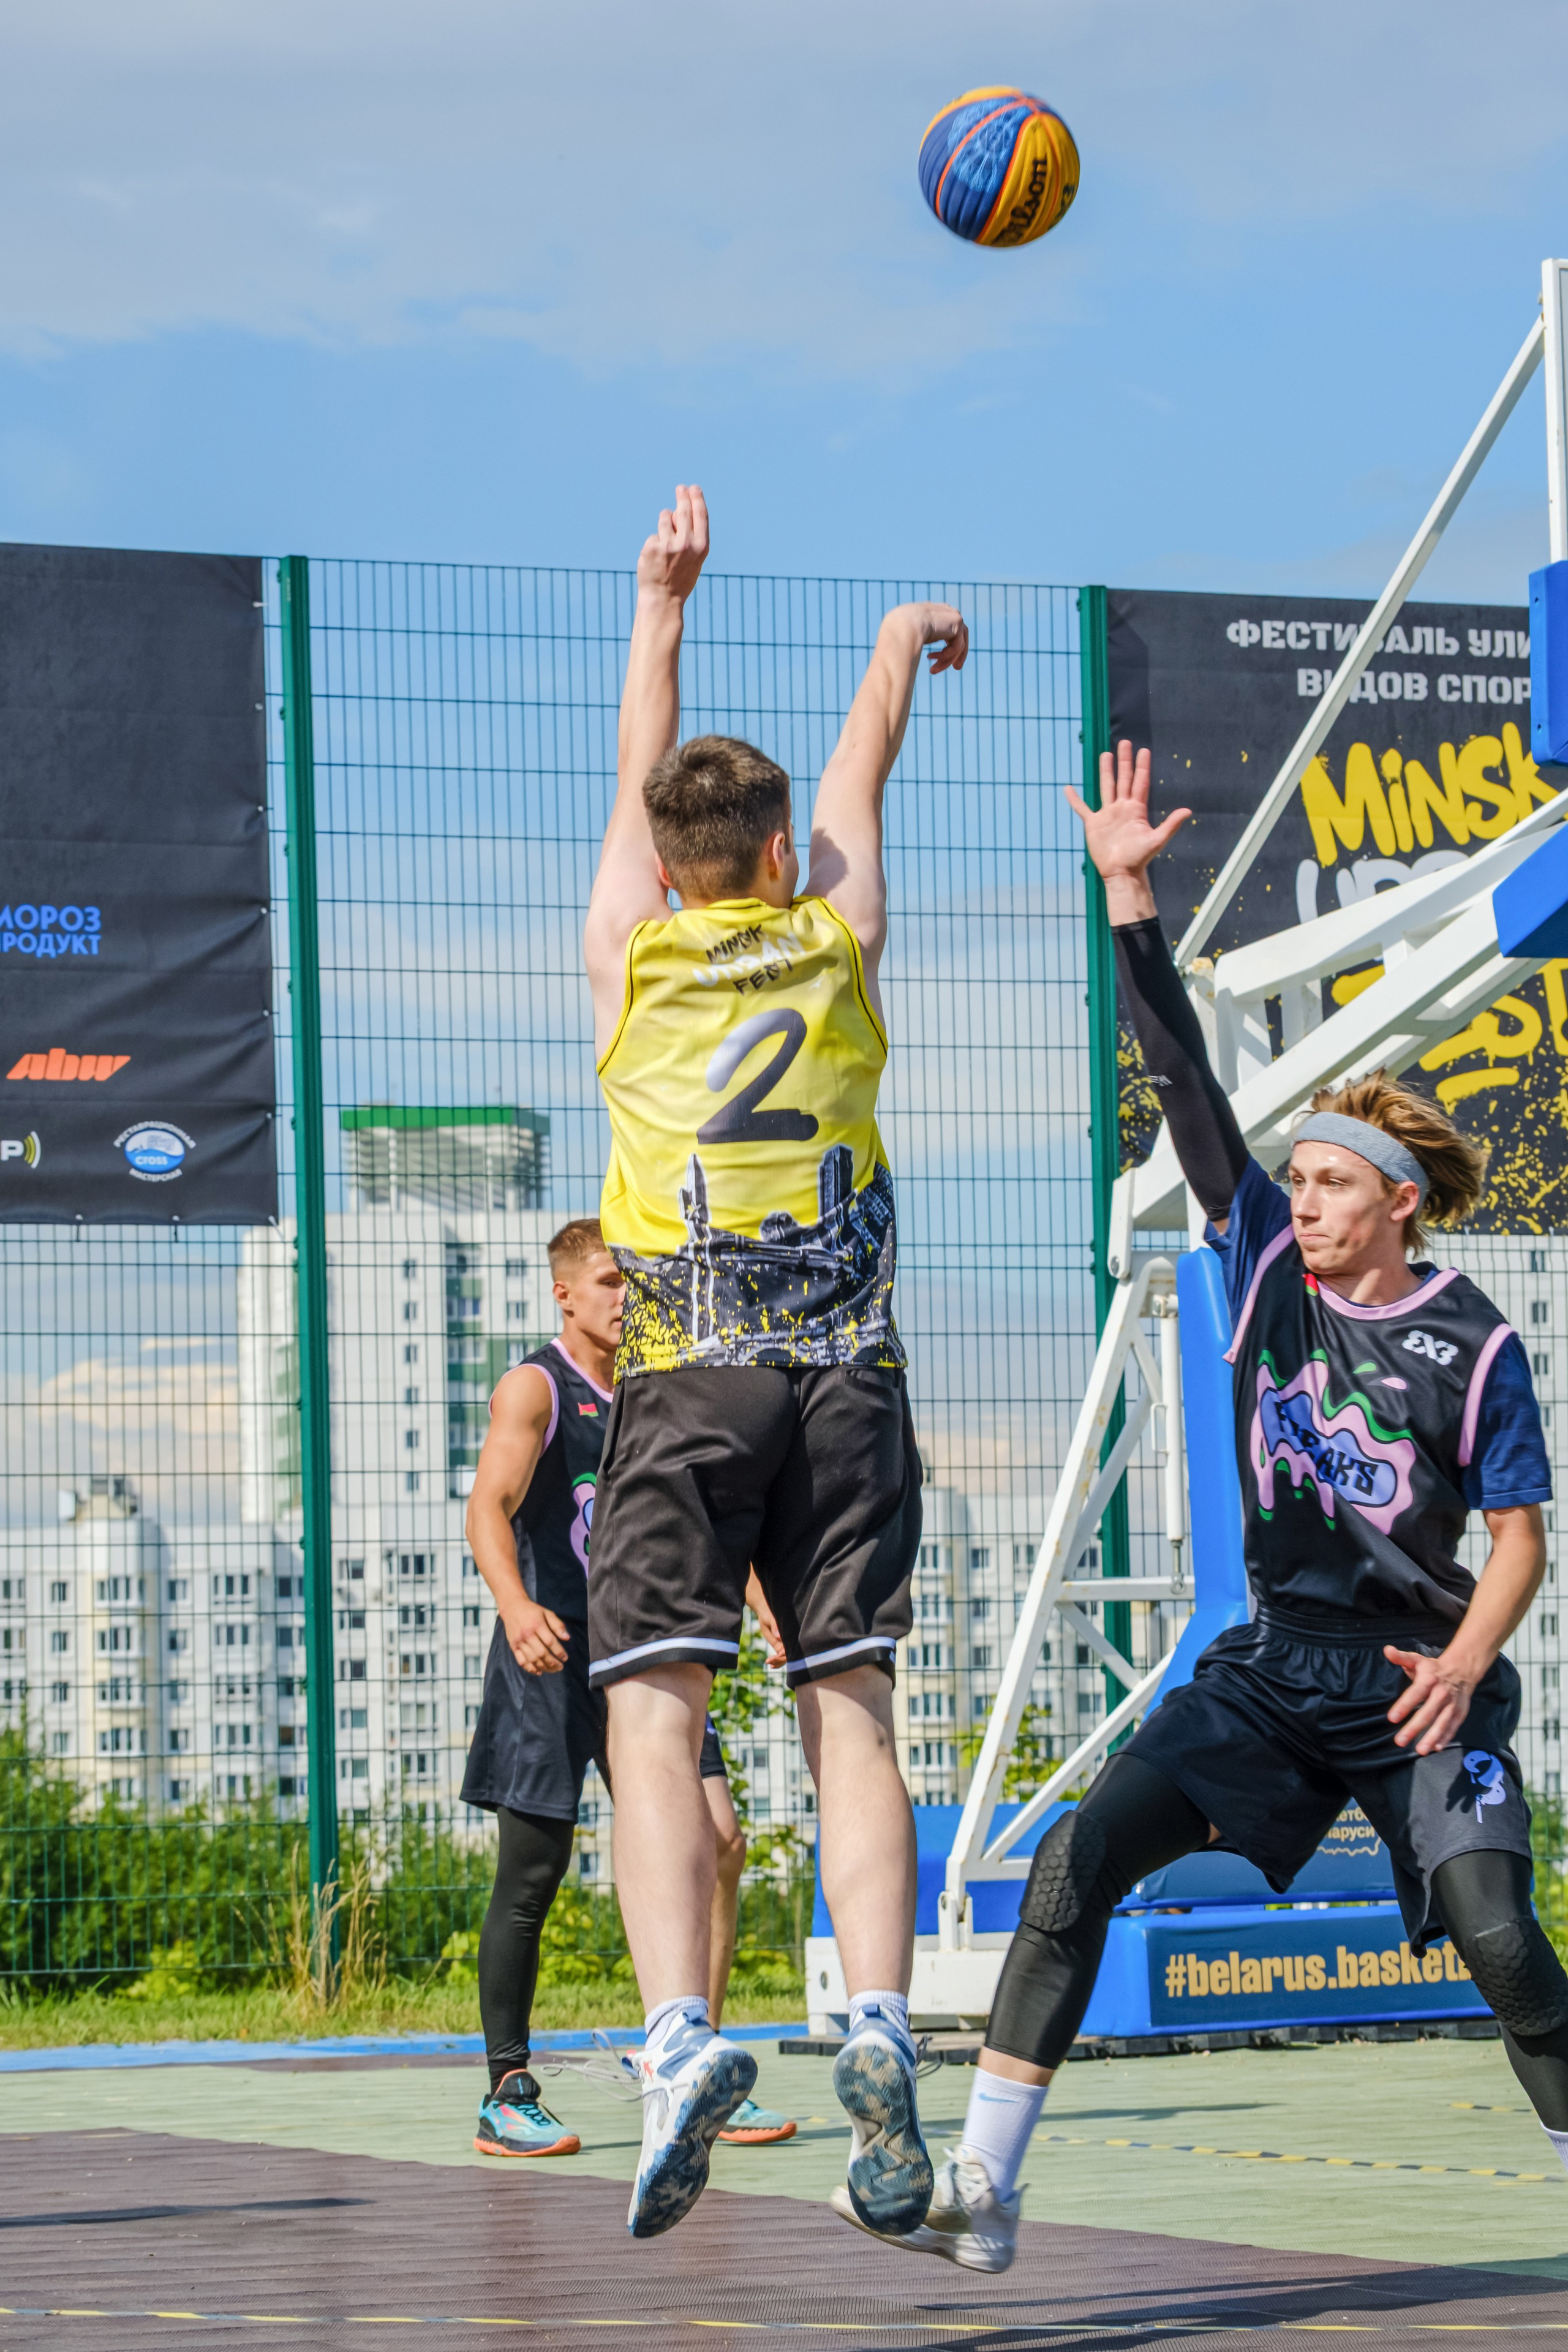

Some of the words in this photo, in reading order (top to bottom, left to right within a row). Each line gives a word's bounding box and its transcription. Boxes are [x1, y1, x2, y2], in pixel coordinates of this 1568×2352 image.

[1226, 619, 1460, 656] ФЕСТИАЛЬ
[0, 931, 102, 959] РОДУКТ
[696, 1008, 820, 1145] 2
